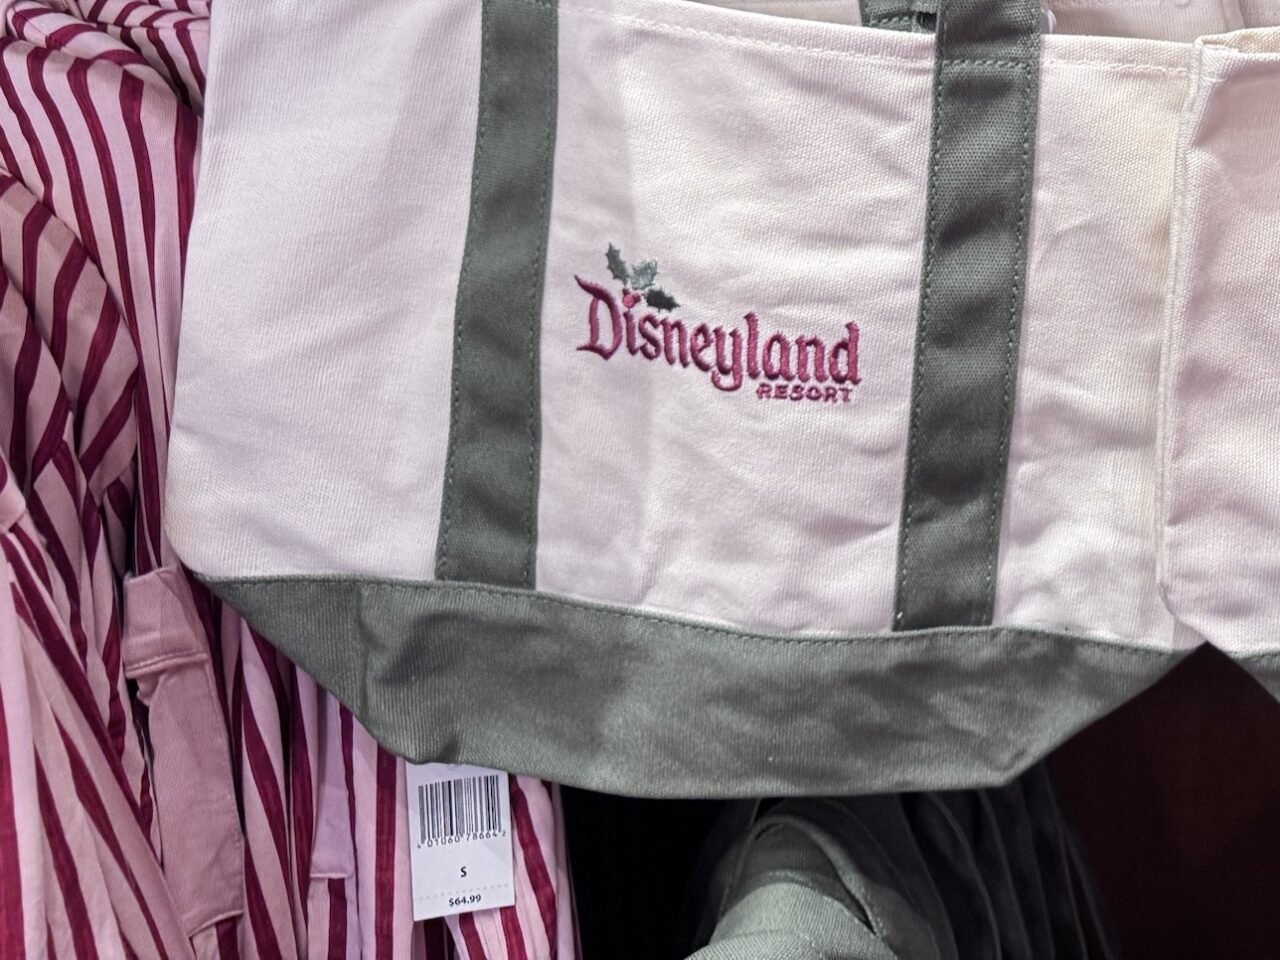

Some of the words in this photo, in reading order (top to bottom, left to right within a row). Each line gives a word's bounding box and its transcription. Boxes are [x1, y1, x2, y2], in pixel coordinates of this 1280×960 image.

[574, 274, 862, 392] Disneyland
[756, 382, 853, 403] RESORT
[460, 866, 467, 878] S
[448, 894, 482, 907] $64.99
